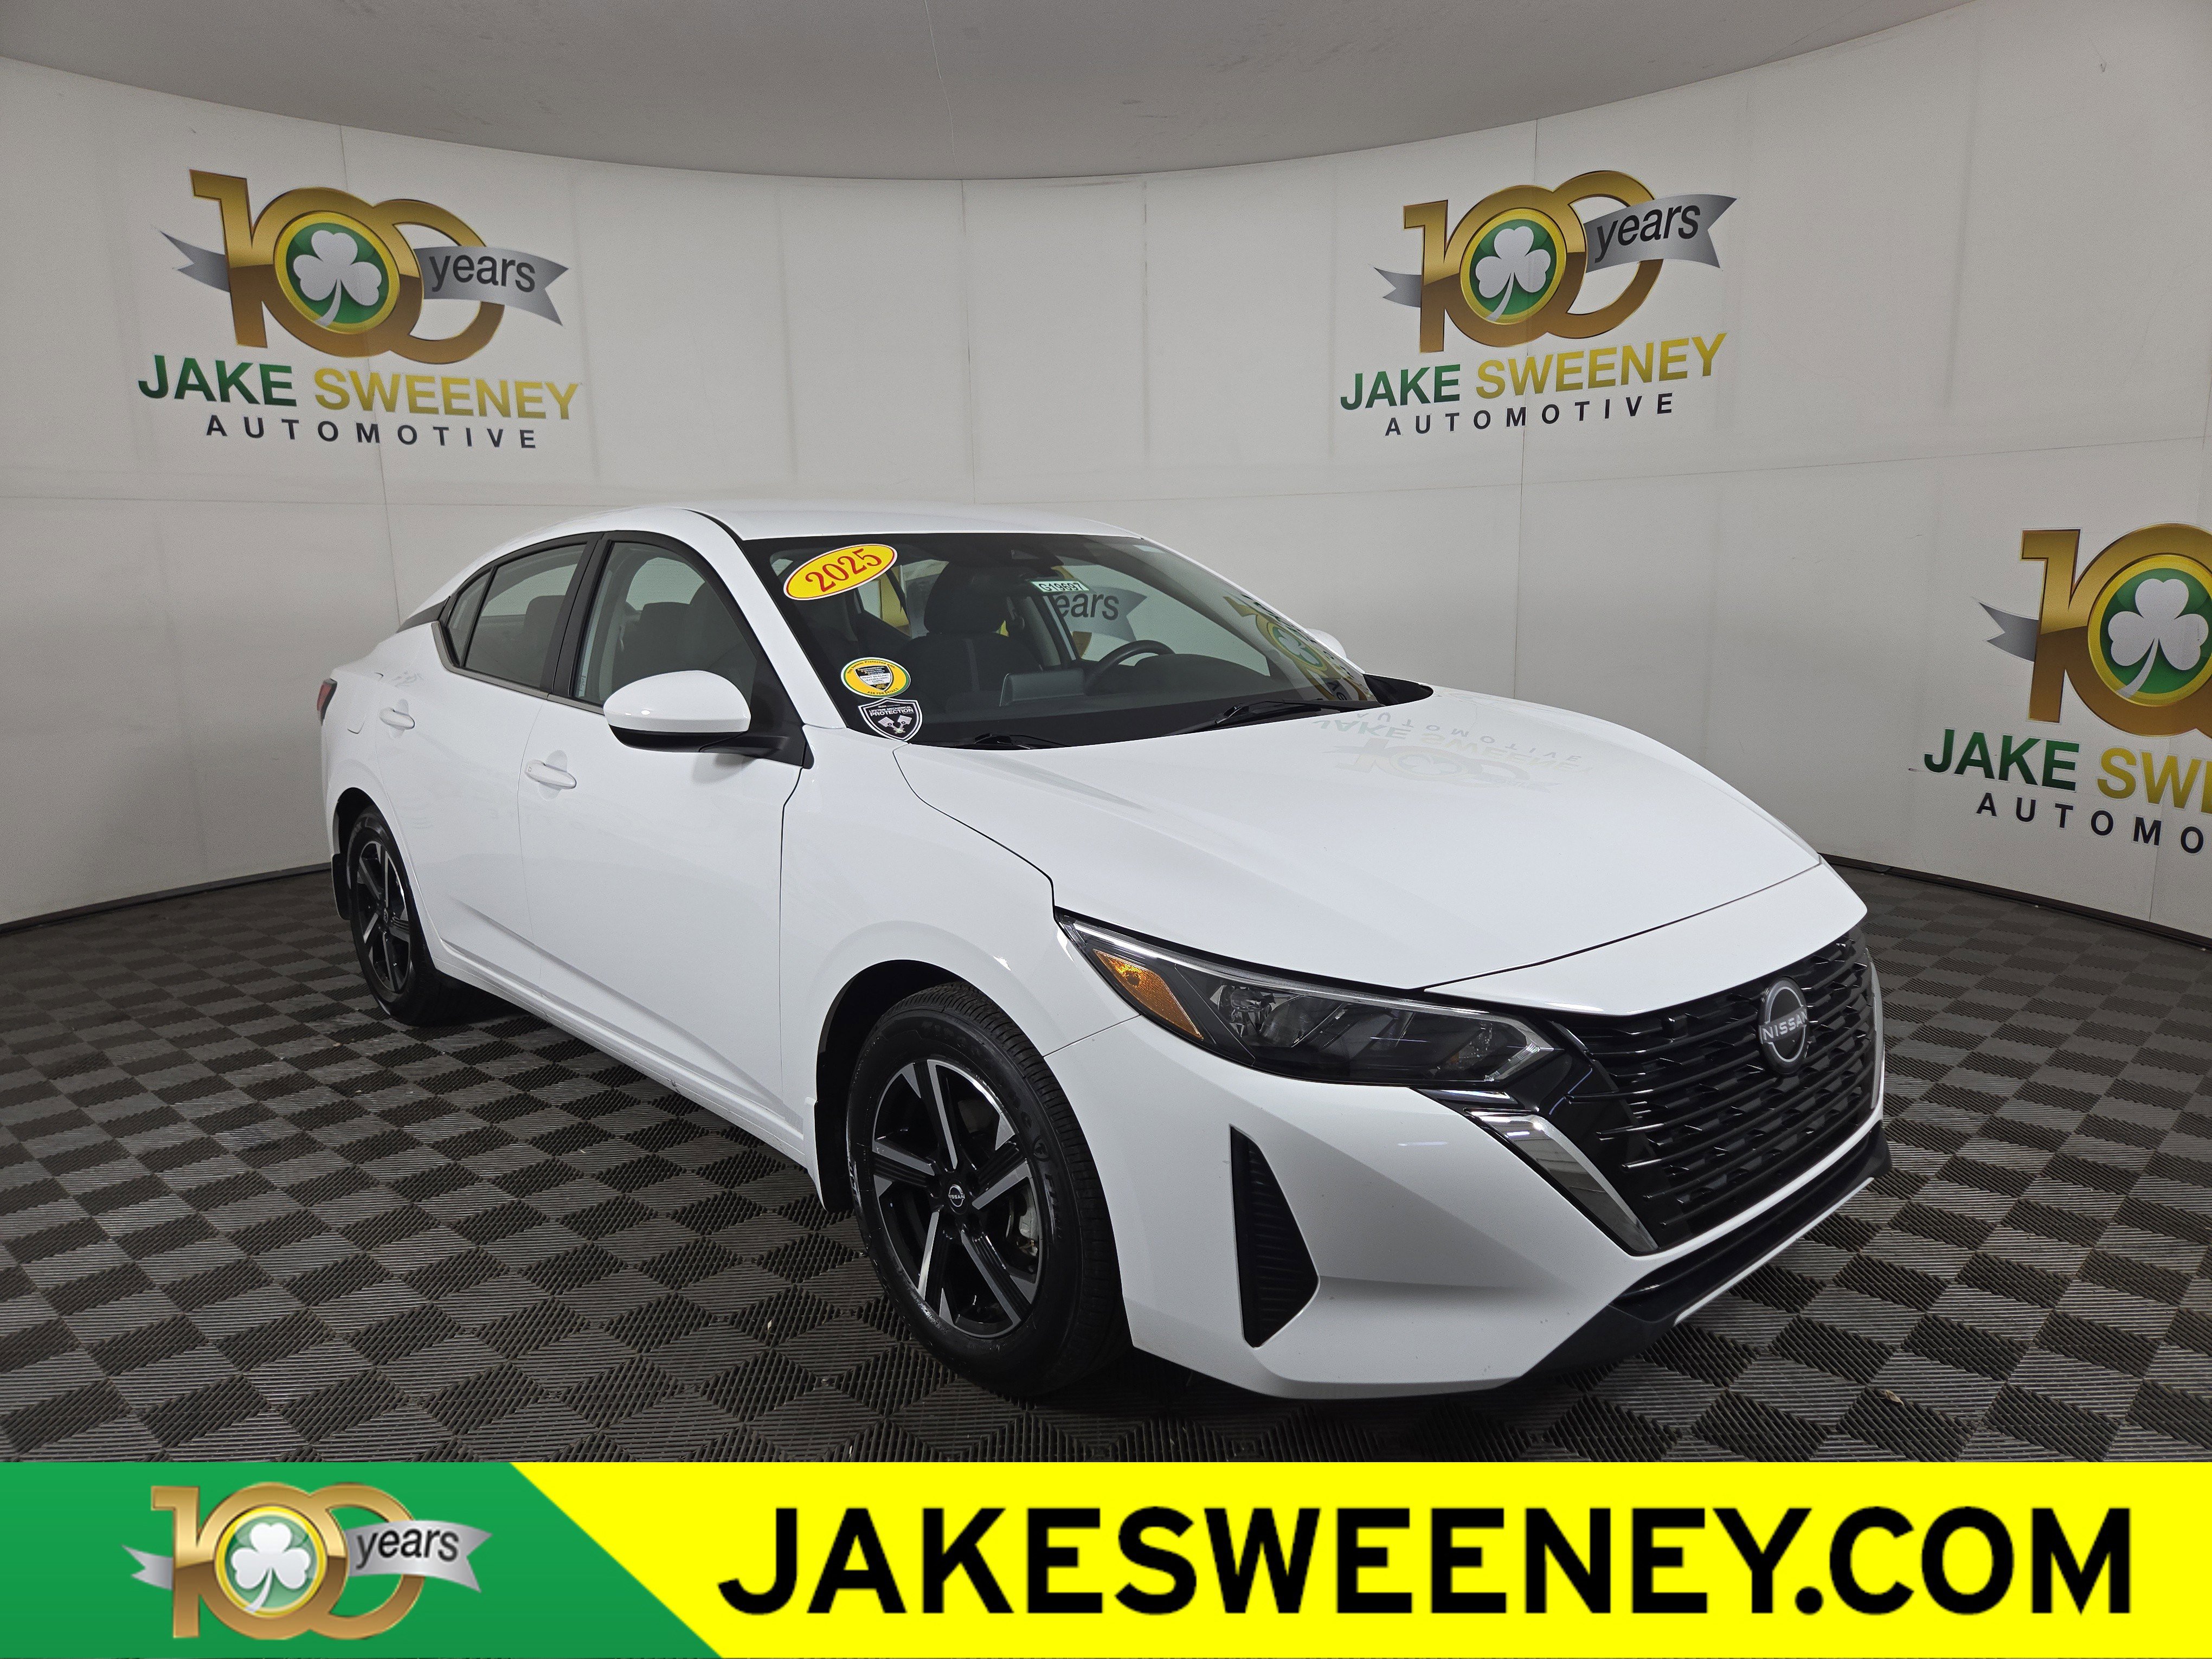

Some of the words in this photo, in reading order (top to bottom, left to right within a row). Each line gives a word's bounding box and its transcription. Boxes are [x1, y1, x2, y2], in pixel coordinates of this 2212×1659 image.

[190, 169, 505, 364] 100
[429, 253, 536, 293] years
[1403, 170, 1664, 353] 100
[1594, 205, 1701, 263] years
[138, 355, 297, 407] JAKE
[314, 368, 579, 420] SWEENEY
[1340, 364, 1461, 411] JAKE
[1476, 333, 1727, 399] SWEENEY
[206, 415, 536, 449] AUTOMOTIVE
[1385, 393, 1673, 436] AUTOMOTIVE
[805, 548, 882, 592] 2025
[1038, 583, 1084, 591] G19697
[1055, 593, 1120, 621] ears
[2020, 523, 2212, 737] 10
[870, 708, 914, 716] PROTECTION
[1924, 729, 2080, 791] JAKE
[2097, 747, 2212, 813] SW
[1763, 1009, 1808, 1040] NISSAN
